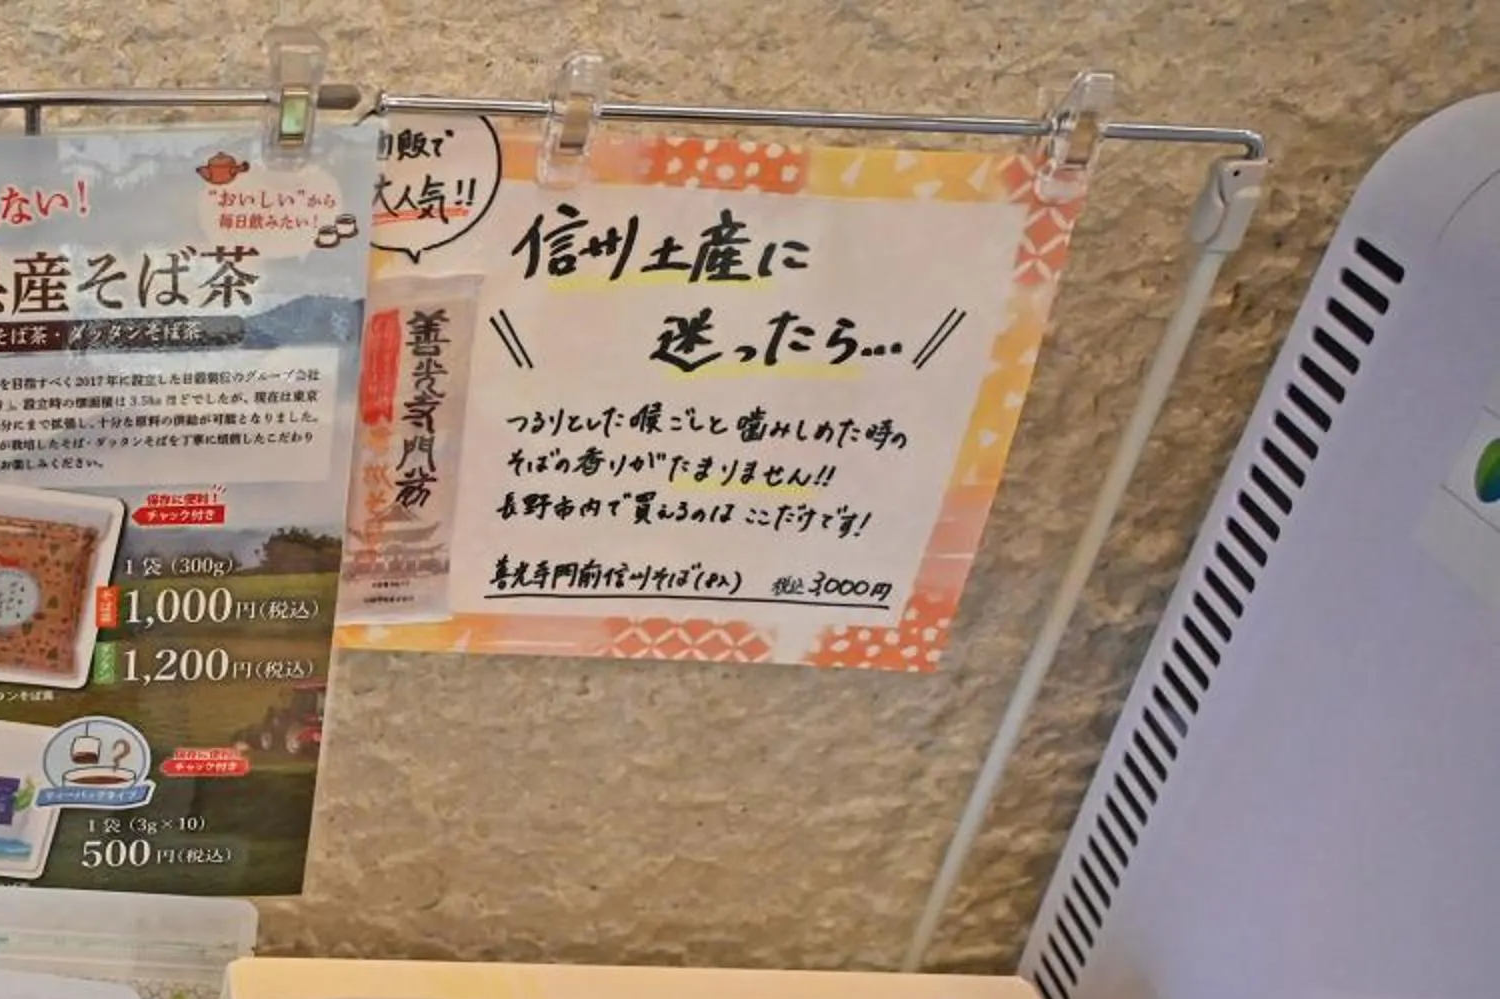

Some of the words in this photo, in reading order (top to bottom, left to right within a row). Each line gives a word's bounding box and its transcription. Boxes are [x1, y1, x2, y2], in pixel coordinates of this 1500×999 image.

[219, 213, 319, 230] 毎日飲みたい!
[511, 203, 811, 283] 信州土産に
[507, 446, 837, 488] そばの香りがたまりません!!
[496, 491, 872, 538] 長野市内で買えるのはここだけです!
